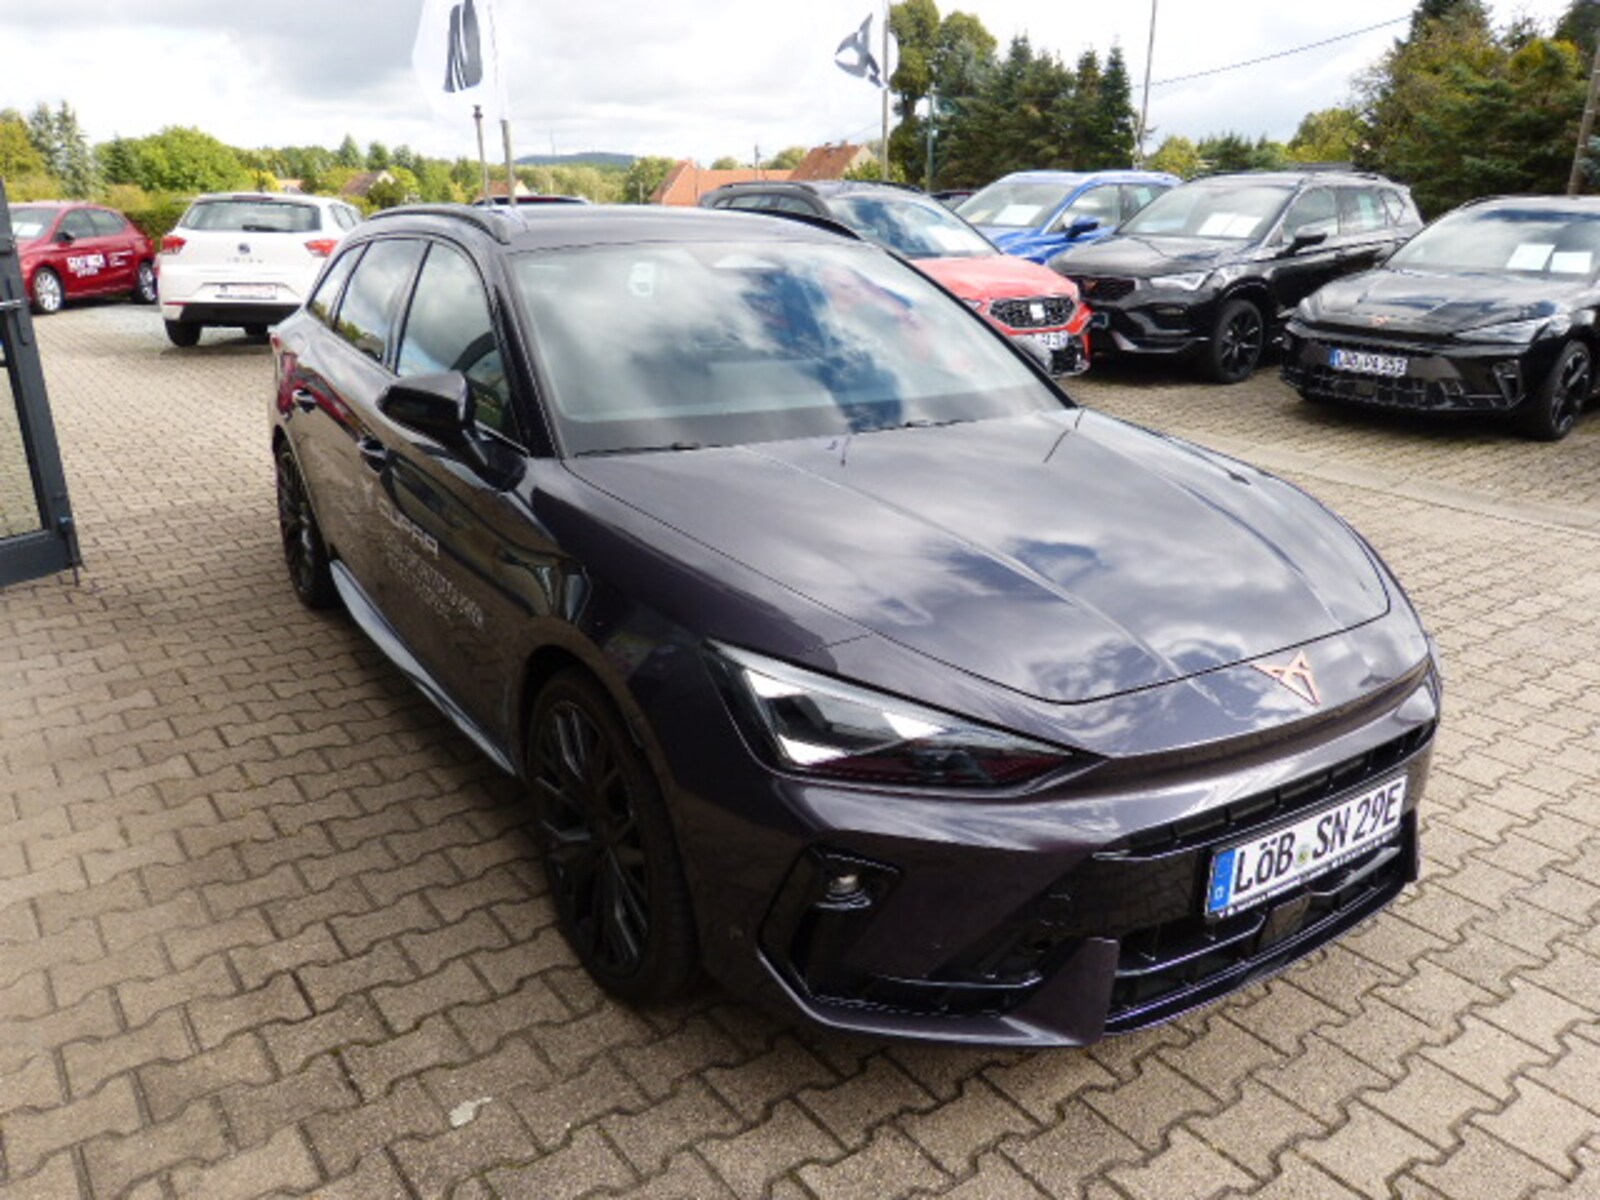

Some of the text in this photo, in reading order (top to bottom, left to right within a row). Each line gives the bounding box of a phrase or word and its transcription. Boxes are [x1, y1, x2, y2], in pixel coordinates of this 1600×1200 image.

[1235, 832, 1296, 892] LÖB
[1313, 807, 1351, 860] SN
[1353, 782, 1403, 840] 29E
